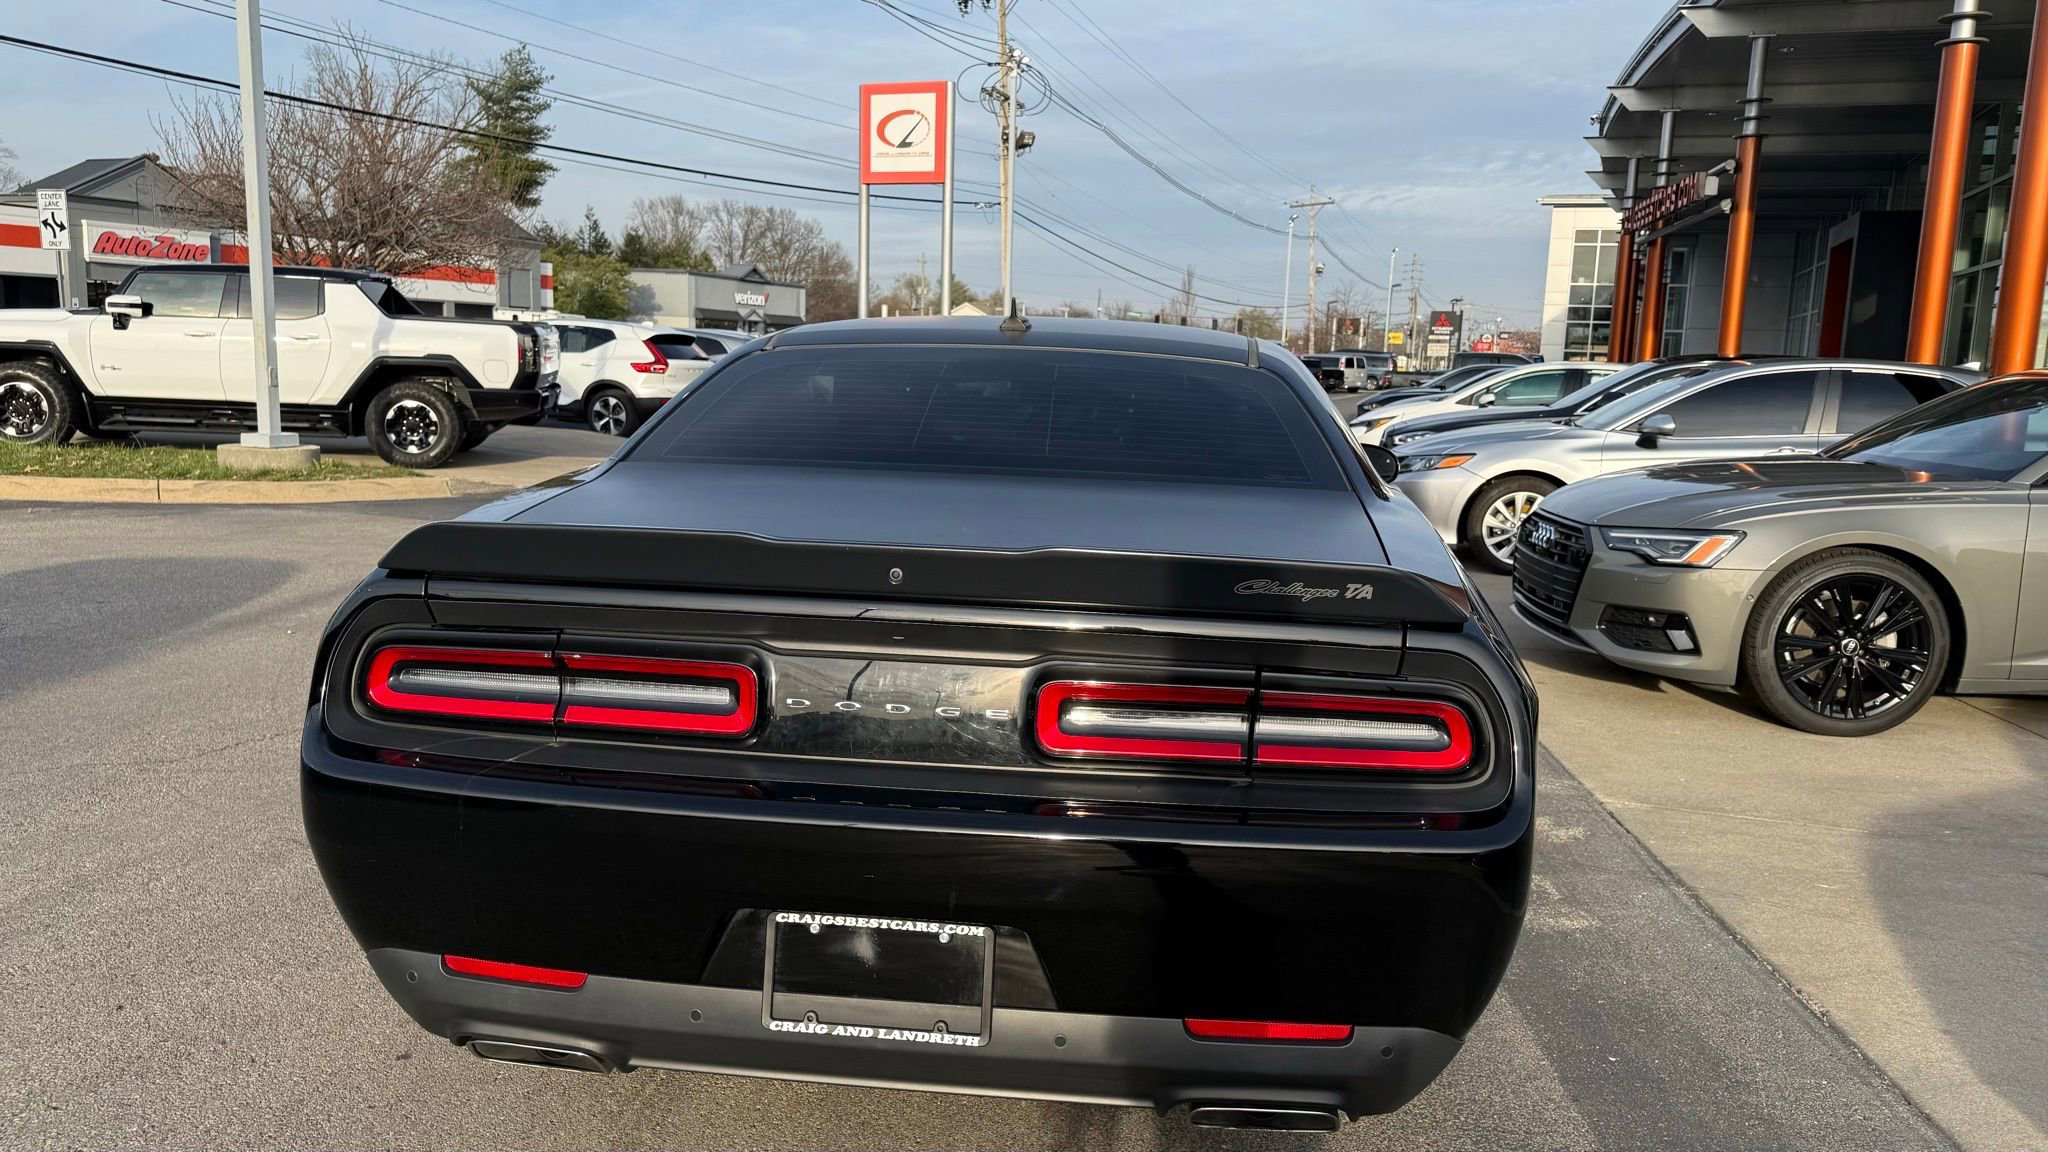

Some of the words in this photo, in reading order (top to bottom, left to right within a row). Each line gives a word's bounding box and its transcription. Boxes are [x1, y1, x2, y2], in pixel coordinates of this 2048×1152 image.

[92, 231, 209, 261] AutoZone
[734, 291, 766, 306] verizon
[1234, 579, 1340, 602] Challenger
[786, 698, 1010, 720] DODGE
[775, 912, 986, 937] CRAIGSBESTCARS.COM
[769, 1020, 829, 1035] CRAIG
[832, 1025, 874, 1039] AND
[876, 1028, 981, 1047] LANDRETH
